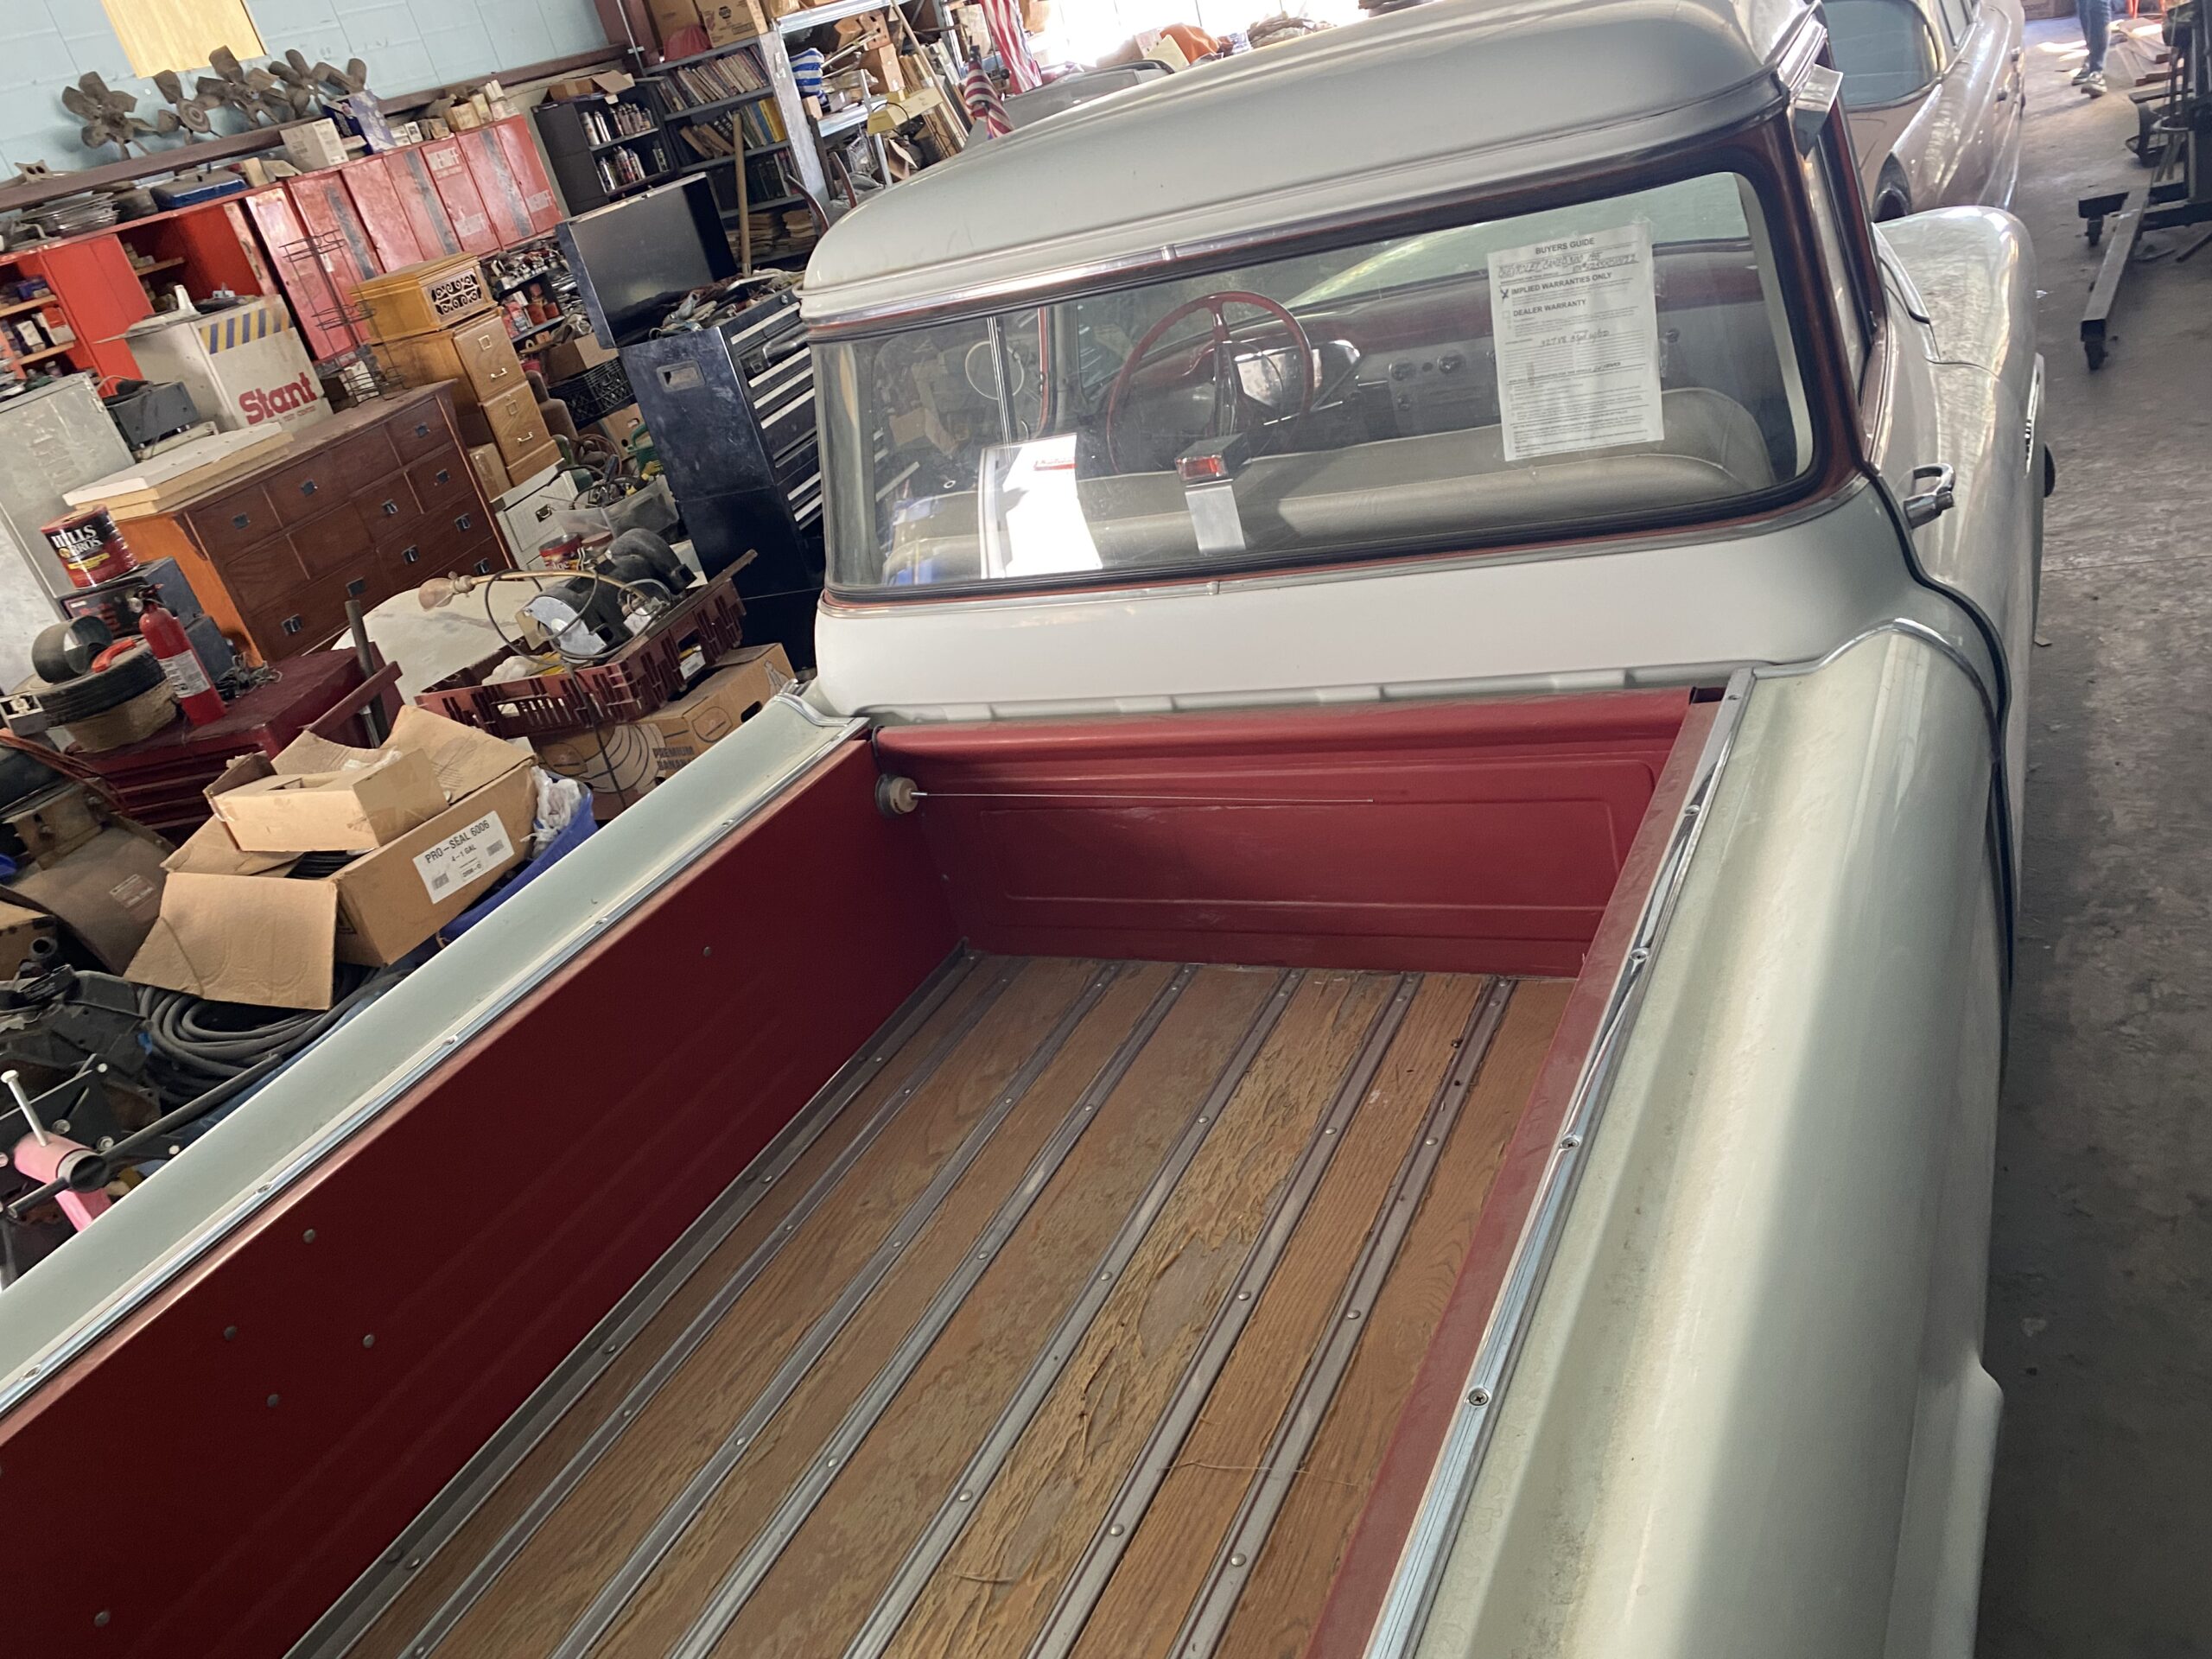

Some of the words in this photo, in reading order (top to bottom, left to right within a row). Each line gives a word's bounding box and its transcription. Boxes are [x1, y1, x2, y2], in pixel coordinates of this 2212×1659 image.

[1535, 242, 1568, 254] BUYERS
[1569, 238, 1596, 248] GUIDE
[1511, 284, 1541, 295] IMPLIED
[1541, 276, 1592, 289] WARRANTIES
[1592, 272, 1613, 282] ONLY
[1513, 305, 1543, 316] DEALER
[1544, 299, 1587, 311] WARRANTY
[238, 372, 318, 425] Stant
[50, 524, 97, 549] HILLS
[652, 747, 695, 759] PREMIUM
[424, 831, 471, 863] PRO-SEAL
[471, 820, 491, 836] 6006
[464, 844, 477, 855] GAL
